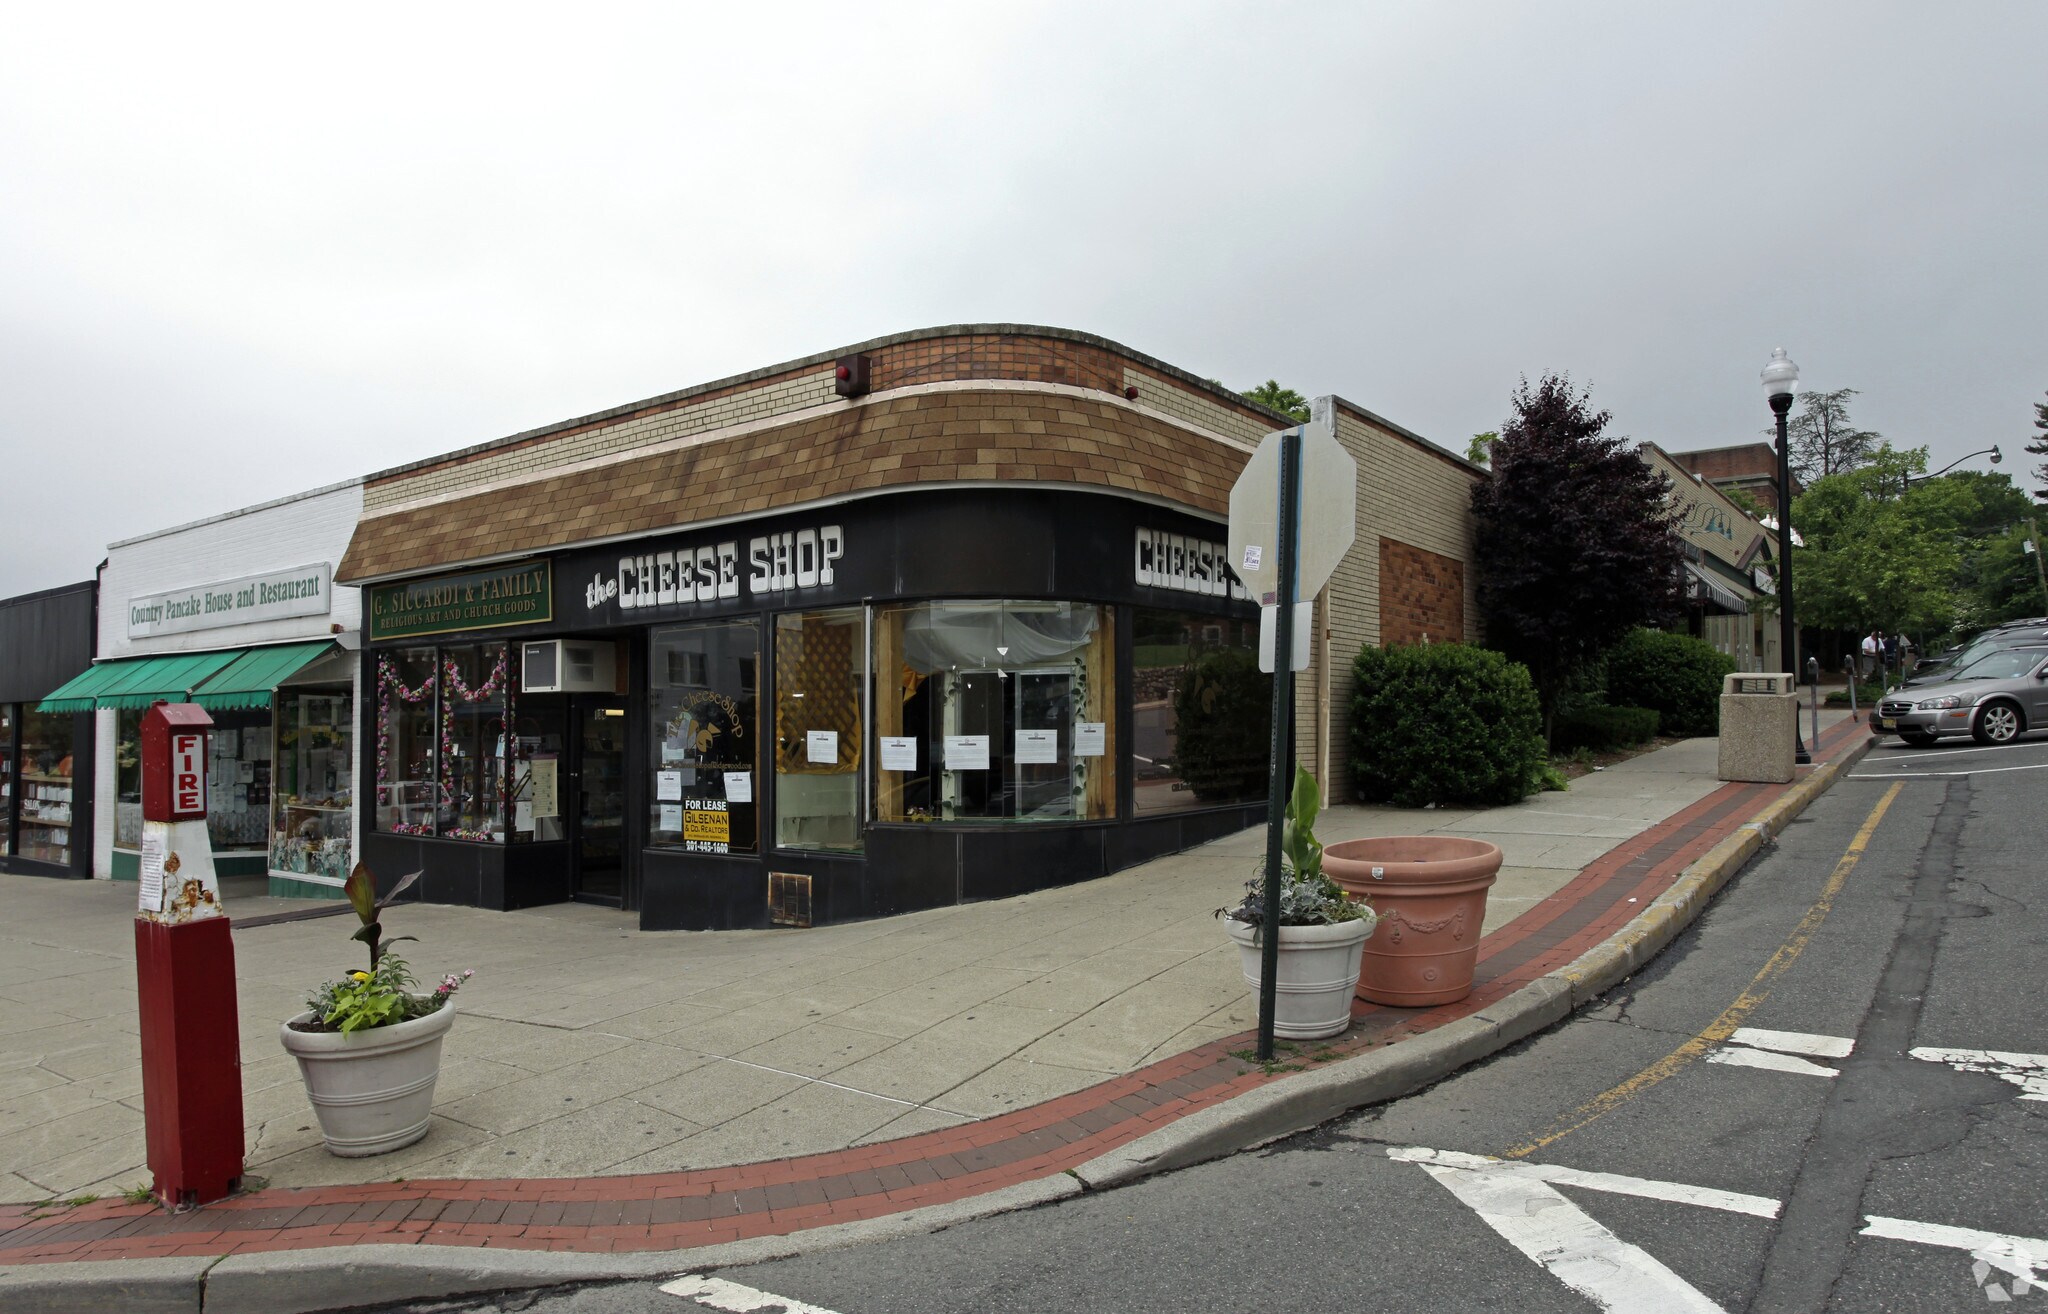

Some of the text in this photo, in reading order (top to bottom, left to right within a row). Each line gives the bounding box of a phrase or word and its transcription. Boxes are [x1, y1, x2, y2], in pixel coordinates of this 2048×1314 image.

[585, 524, 845, 610] the CHEESE SHOP
[1135, 526, 1228, 597] CHEESE
[131, 574, 320, 626] Country Pancake House and Restaurant
[374, 570, 544, 616] G. SICCARDI & FAMILY
[381, 599, 536, 629] RELIGIOUS ART AND CHURCH GOODS
[681, 690, 722, 711] Cheese
[721, 695, 744, 738] Shop
[177, 736, 199, 809] FIRE
[684, 824, 690, 832] &
[685, 800, 727, 811] FOR LEASE
